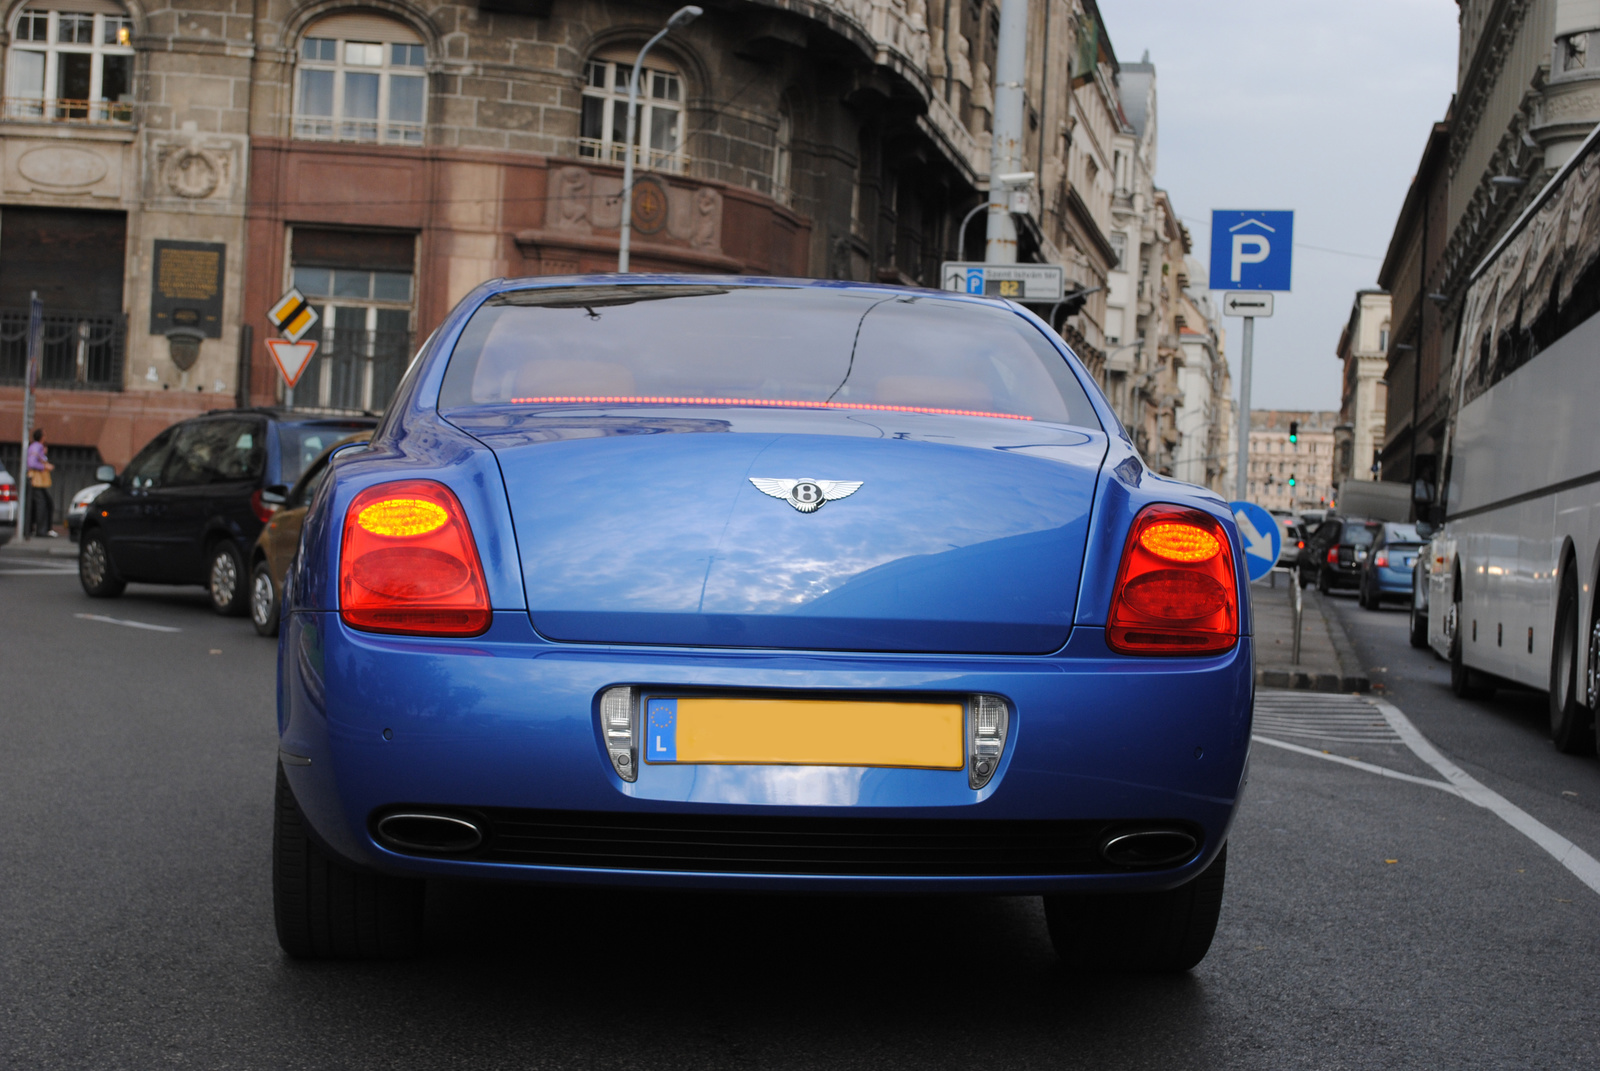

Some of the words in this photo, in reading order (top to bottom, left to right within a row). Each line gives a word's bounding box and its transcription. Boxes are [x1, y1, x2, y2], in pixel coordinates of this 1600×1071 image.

[1231, 234, 1270, 282] P
[971, 278, 980, 292] P
[1000, 280, 1019, 296] 82
[797, 484, 817, 502] B
[656, 735, 667, 752] L
